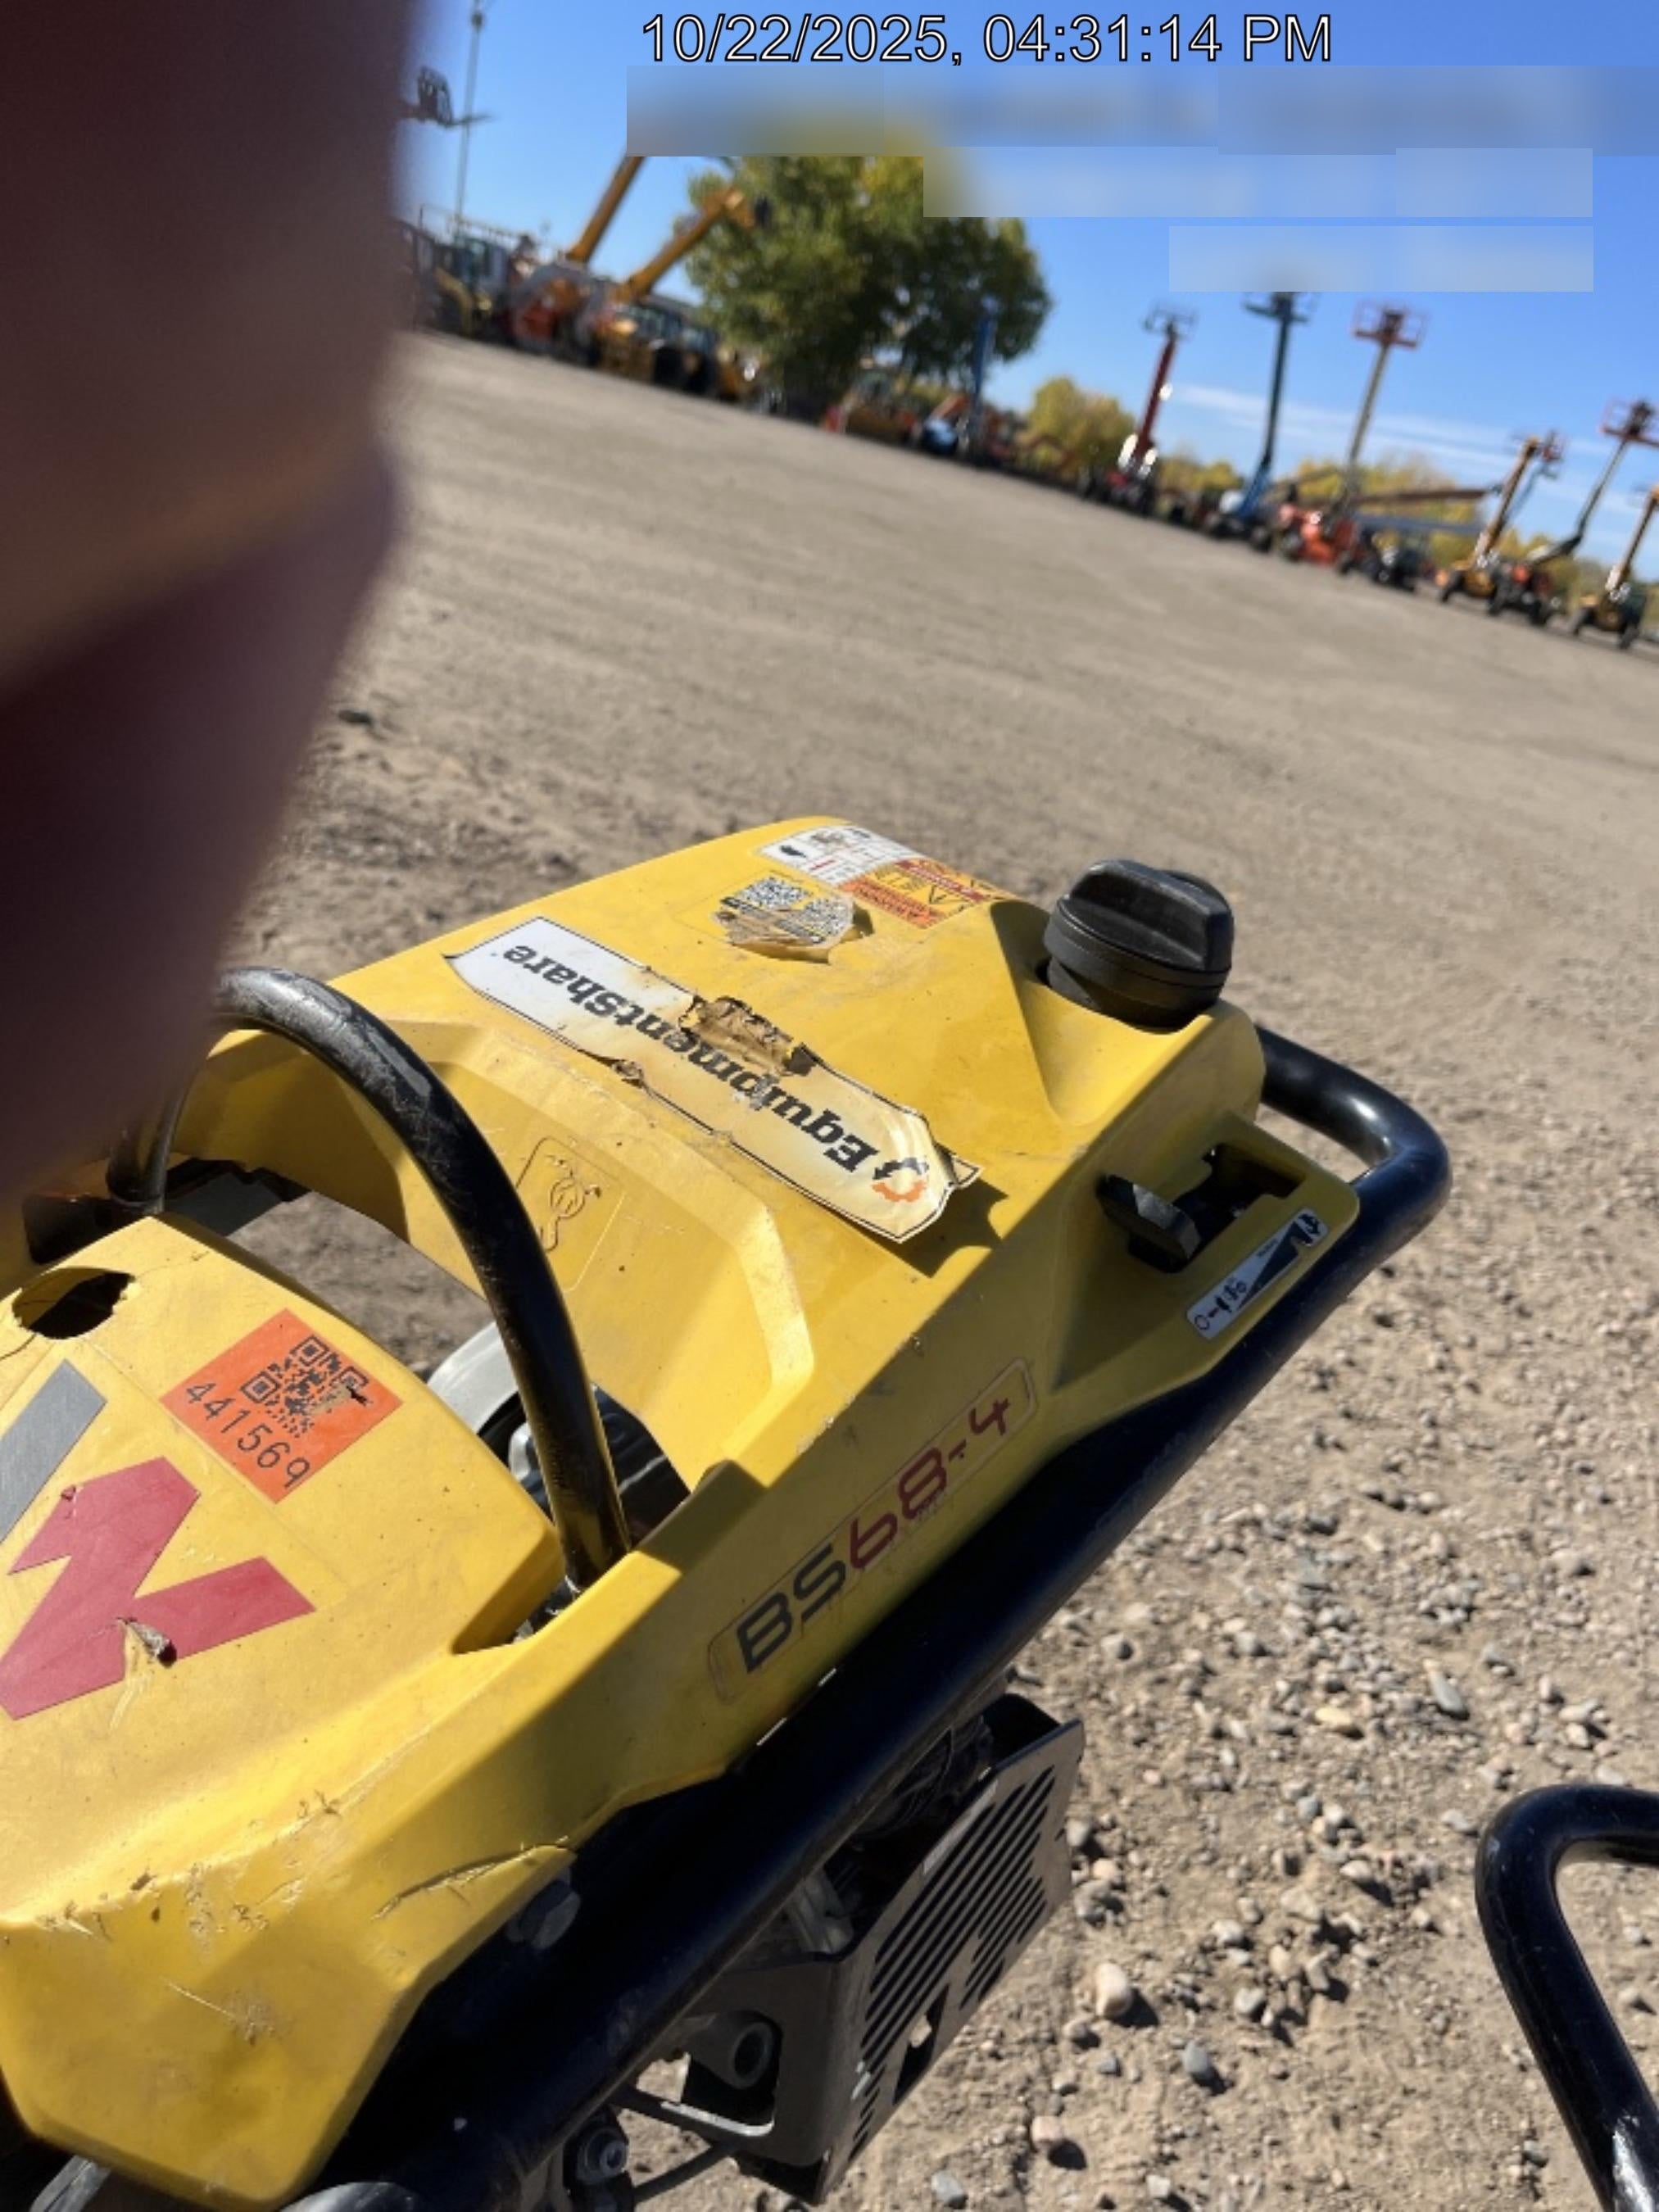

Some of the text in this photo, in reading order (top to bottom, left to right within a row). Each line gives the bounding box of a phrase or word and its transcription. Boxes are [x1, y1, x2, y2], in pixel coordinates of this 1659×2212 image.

[502, 944, 880, 1173] EquipmentShare
[186, 1382, 310, 1488] 441569
[737, 1396, 1009, 1675] BS68-4
